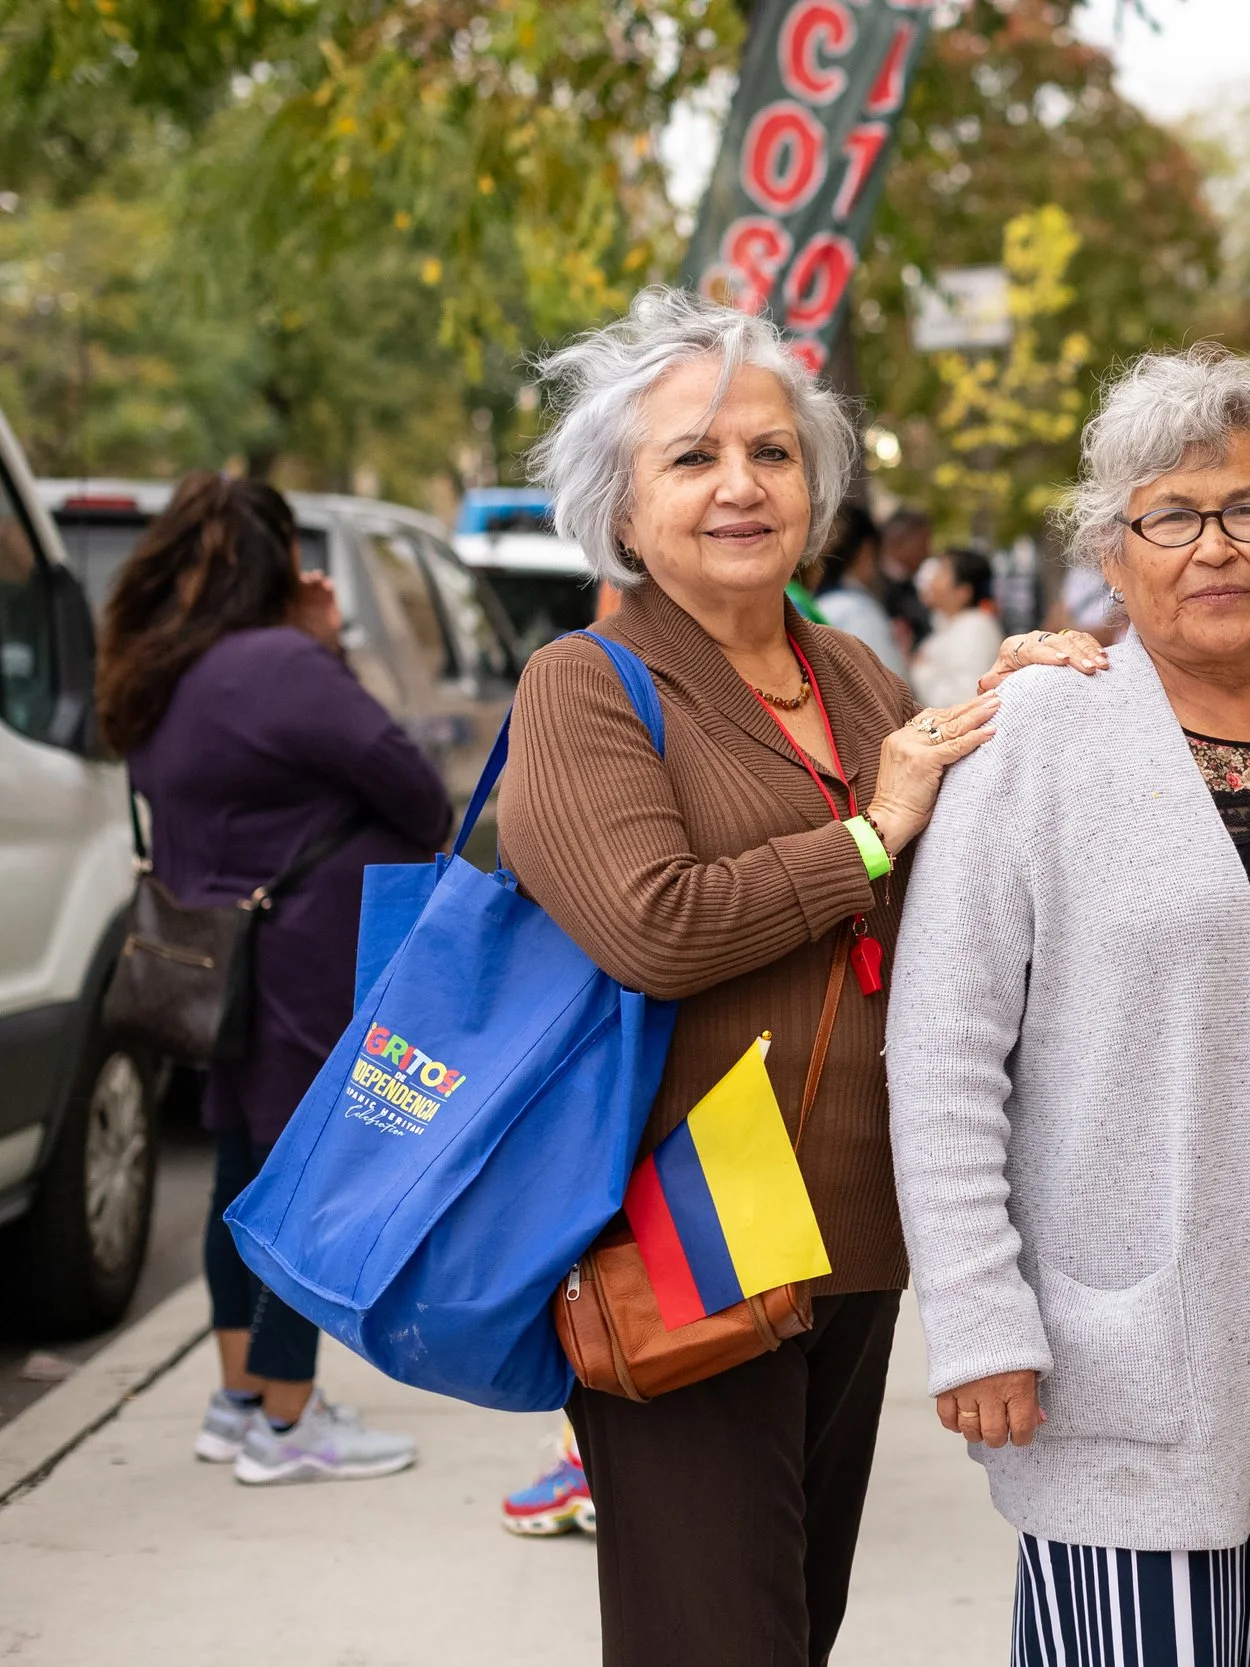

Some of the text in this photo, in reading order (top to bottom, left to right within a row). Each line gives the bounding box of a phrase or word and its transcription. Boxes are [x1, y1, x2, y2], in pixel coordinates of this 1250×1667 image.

[699, 0, 871, 316] COS
[394, 1071, 407, 1083] DE
[344, 1104, 406, 1137] Celebration
